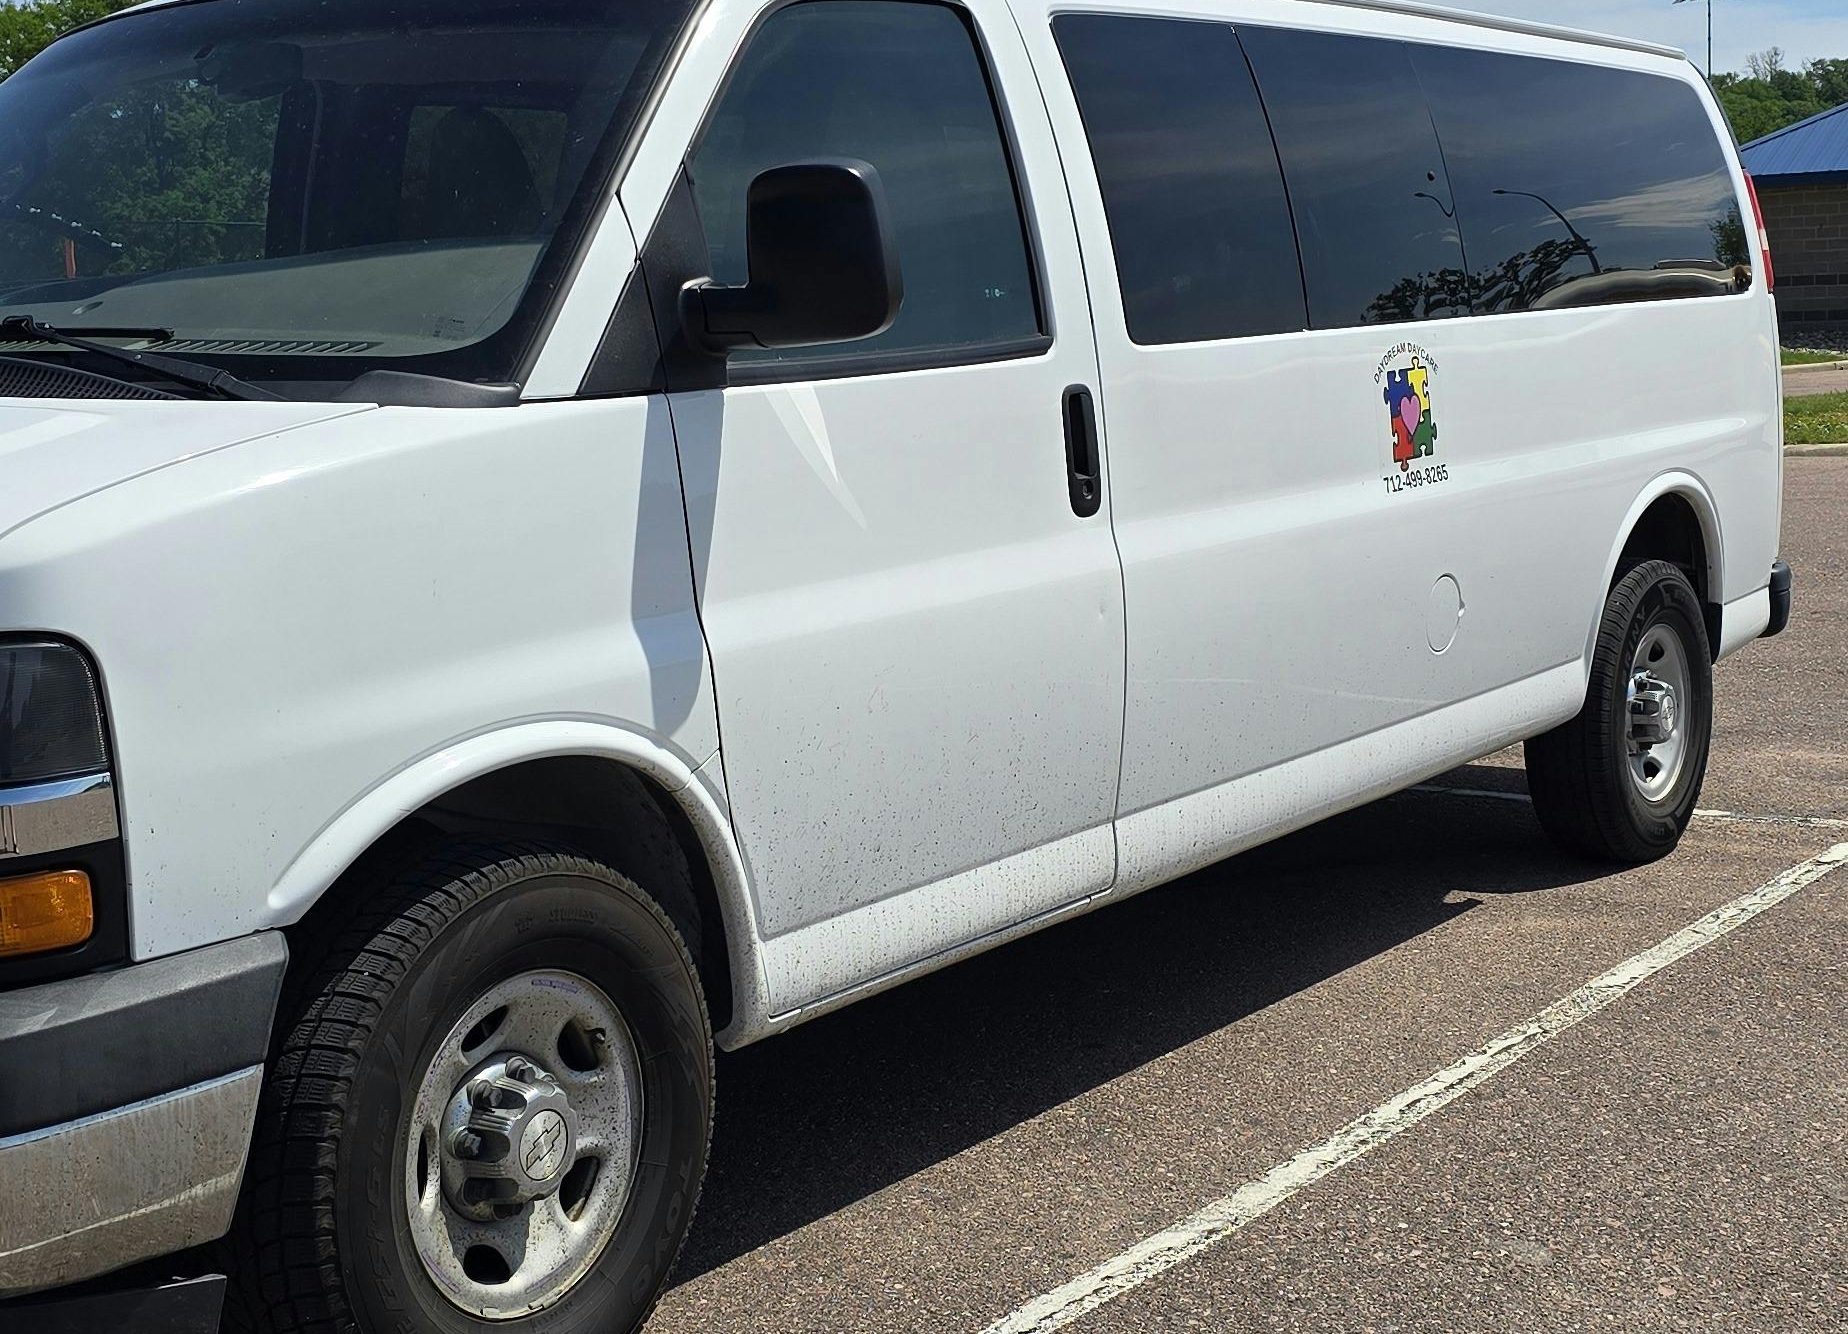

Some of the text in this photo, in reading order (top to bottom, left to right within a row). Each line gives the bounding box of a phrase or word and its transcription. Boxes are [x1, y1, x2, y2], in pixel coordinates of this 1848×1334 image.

[1373, 342, 1439, 385] DAYDREAM DAYCARE
[1383, 464, 1449, 494] 712-499-8265
[631, 1154, 693, 1306] TOYO
